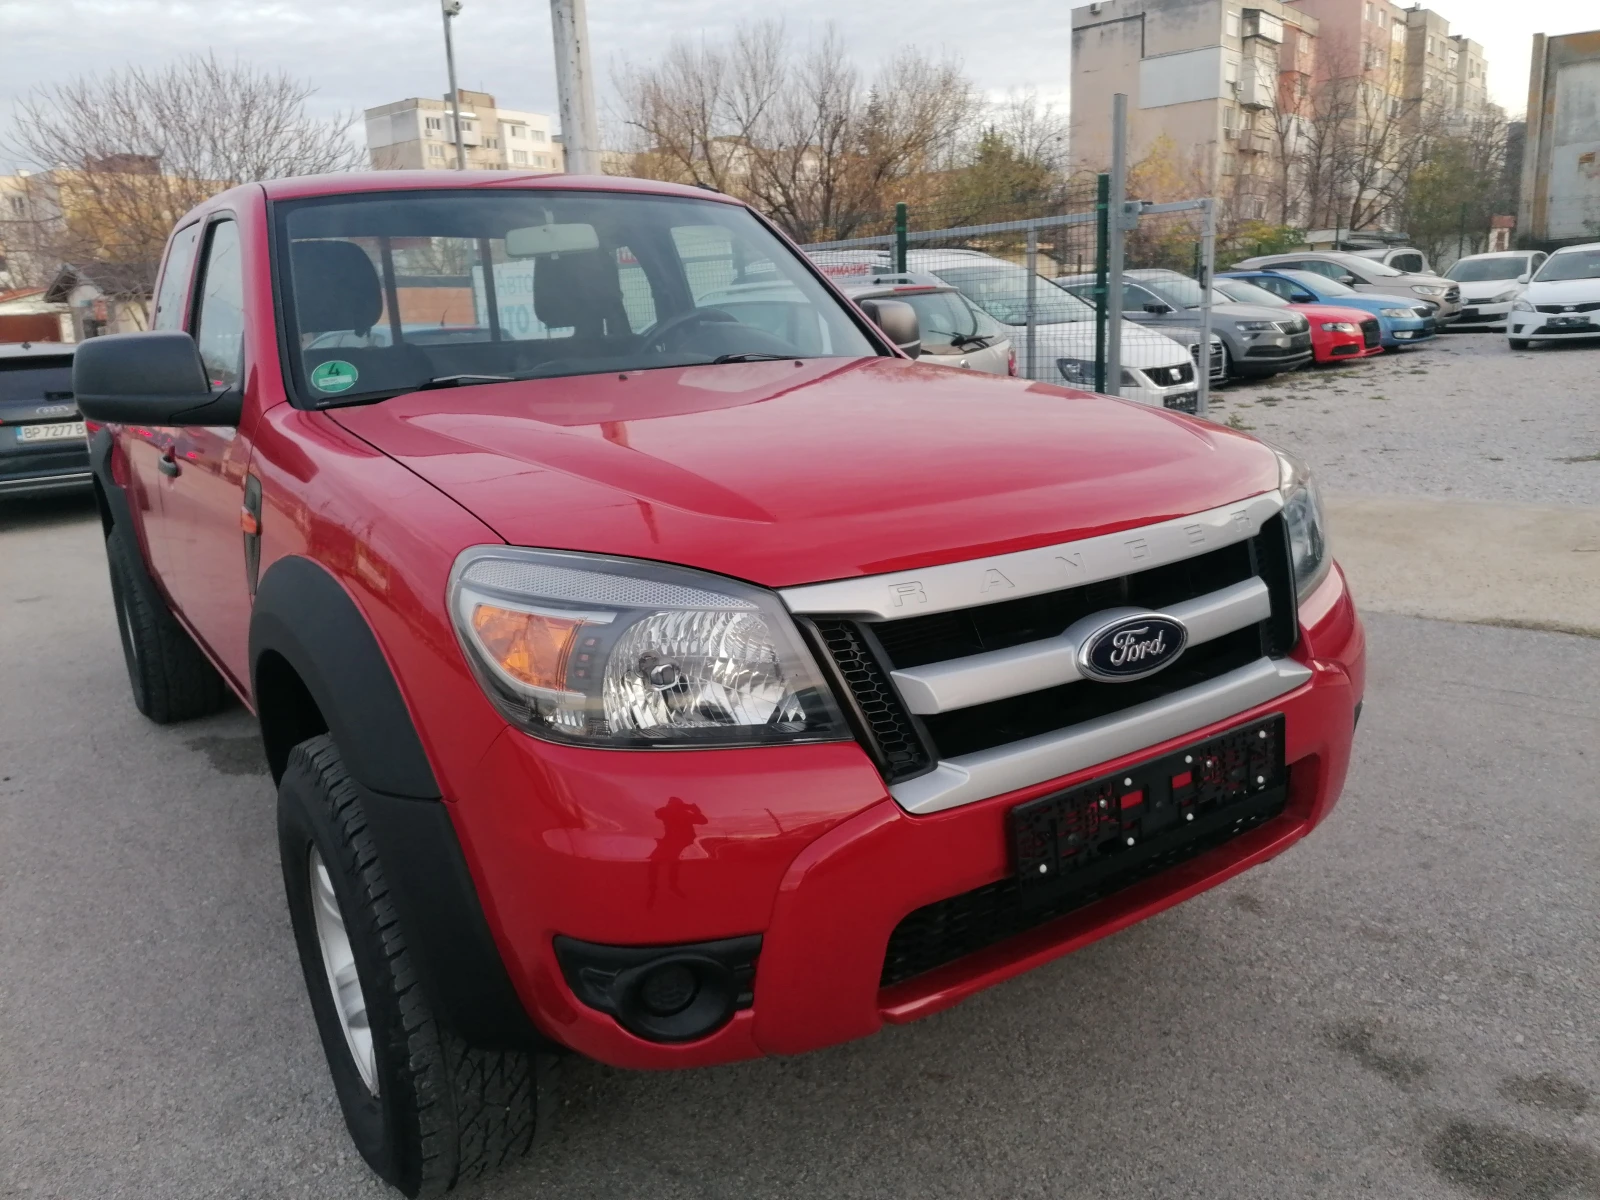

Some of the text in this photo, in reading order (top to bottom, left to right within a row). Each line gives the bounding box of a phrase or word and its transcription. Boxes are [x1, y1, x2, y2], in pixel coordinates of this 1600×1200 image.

[820, 263, 870, 277] НИМАНИЕ
[328, 363, 341, 376] 4
[24, 427, 40, 439] BP
[43, 424, 73, 437] 7277
[887, 508, 1256, 608] RANGER
[1110, 625, 1168, 668] Ford
